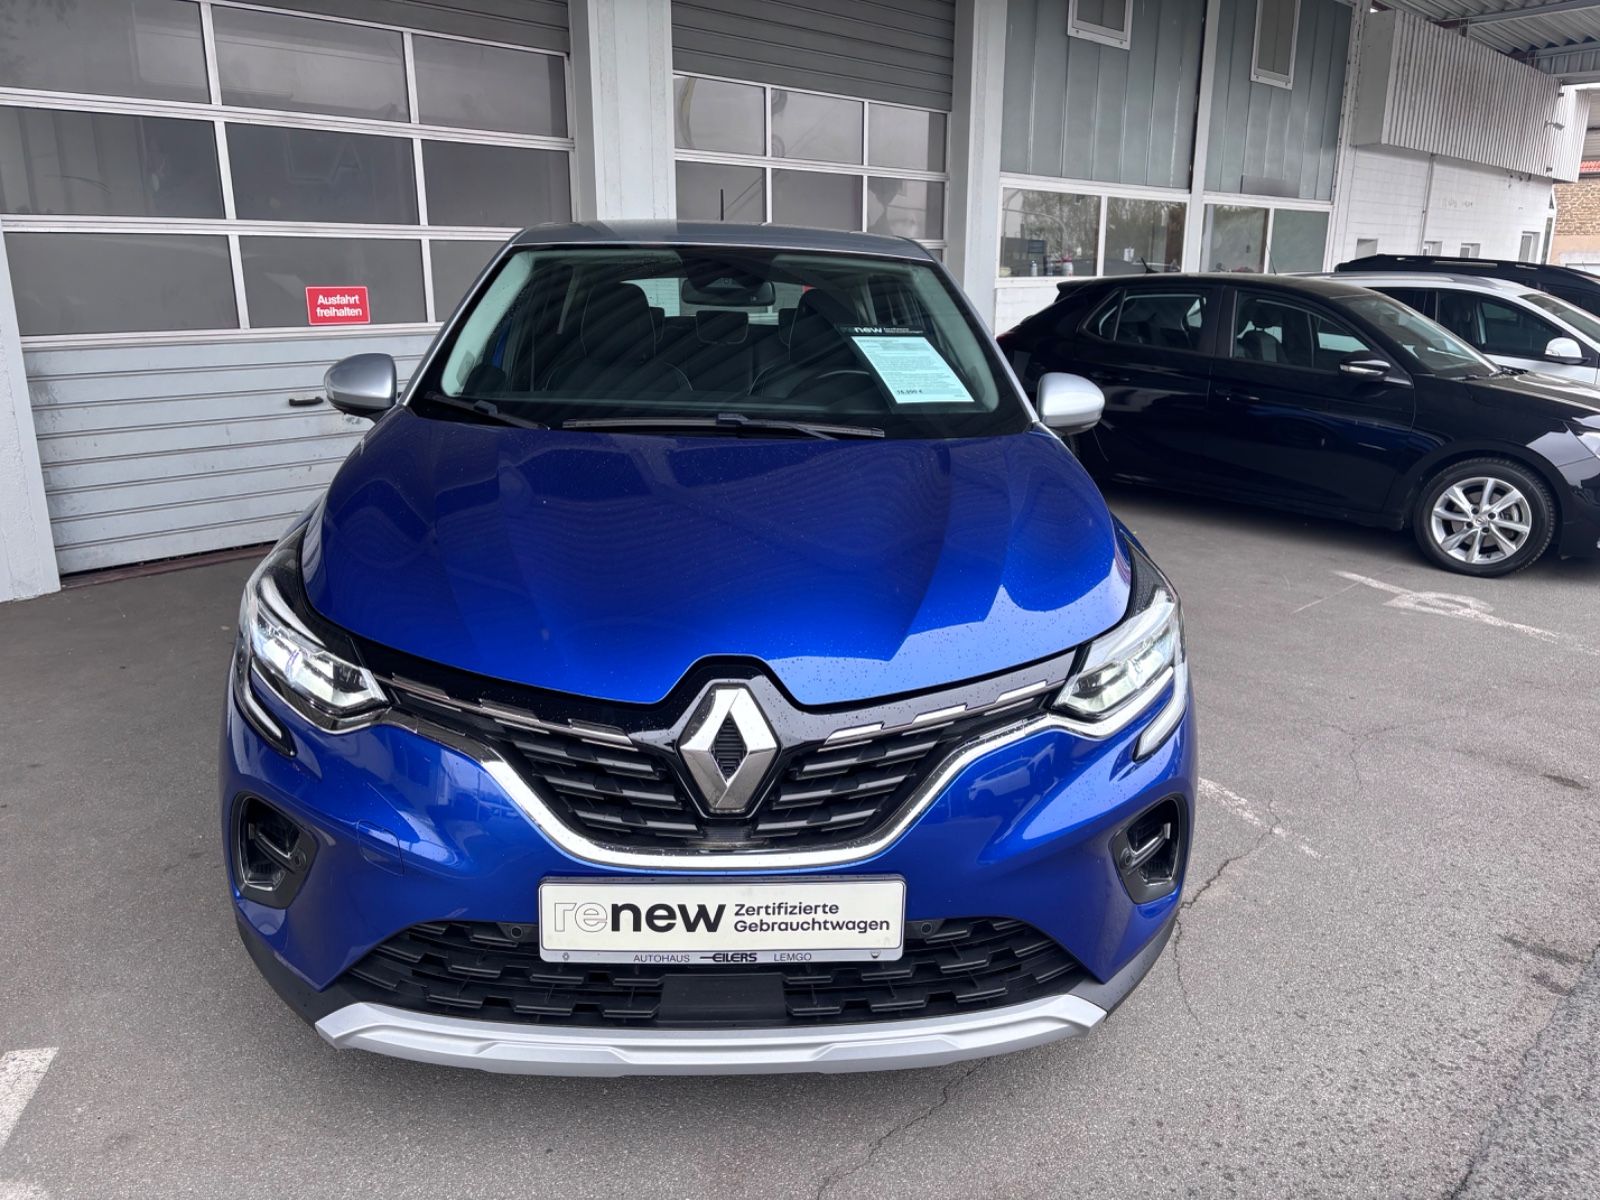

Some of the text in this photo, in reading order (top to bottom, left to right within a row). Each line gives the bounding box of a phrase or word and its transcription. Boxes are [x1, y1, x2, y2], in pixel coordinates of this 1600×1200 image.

[317, 294, 360, 305] Ausfahrt
[316, 306, 363, 317] freihalten
[734, 902, 840, 917] Zertifizierte
[554, 902, 726, 933] renew
[733, 918, 890, 934] Gebrauchtwagen
[633, 952, 812, 963] AUTOHAUS EILERS LEMGO
